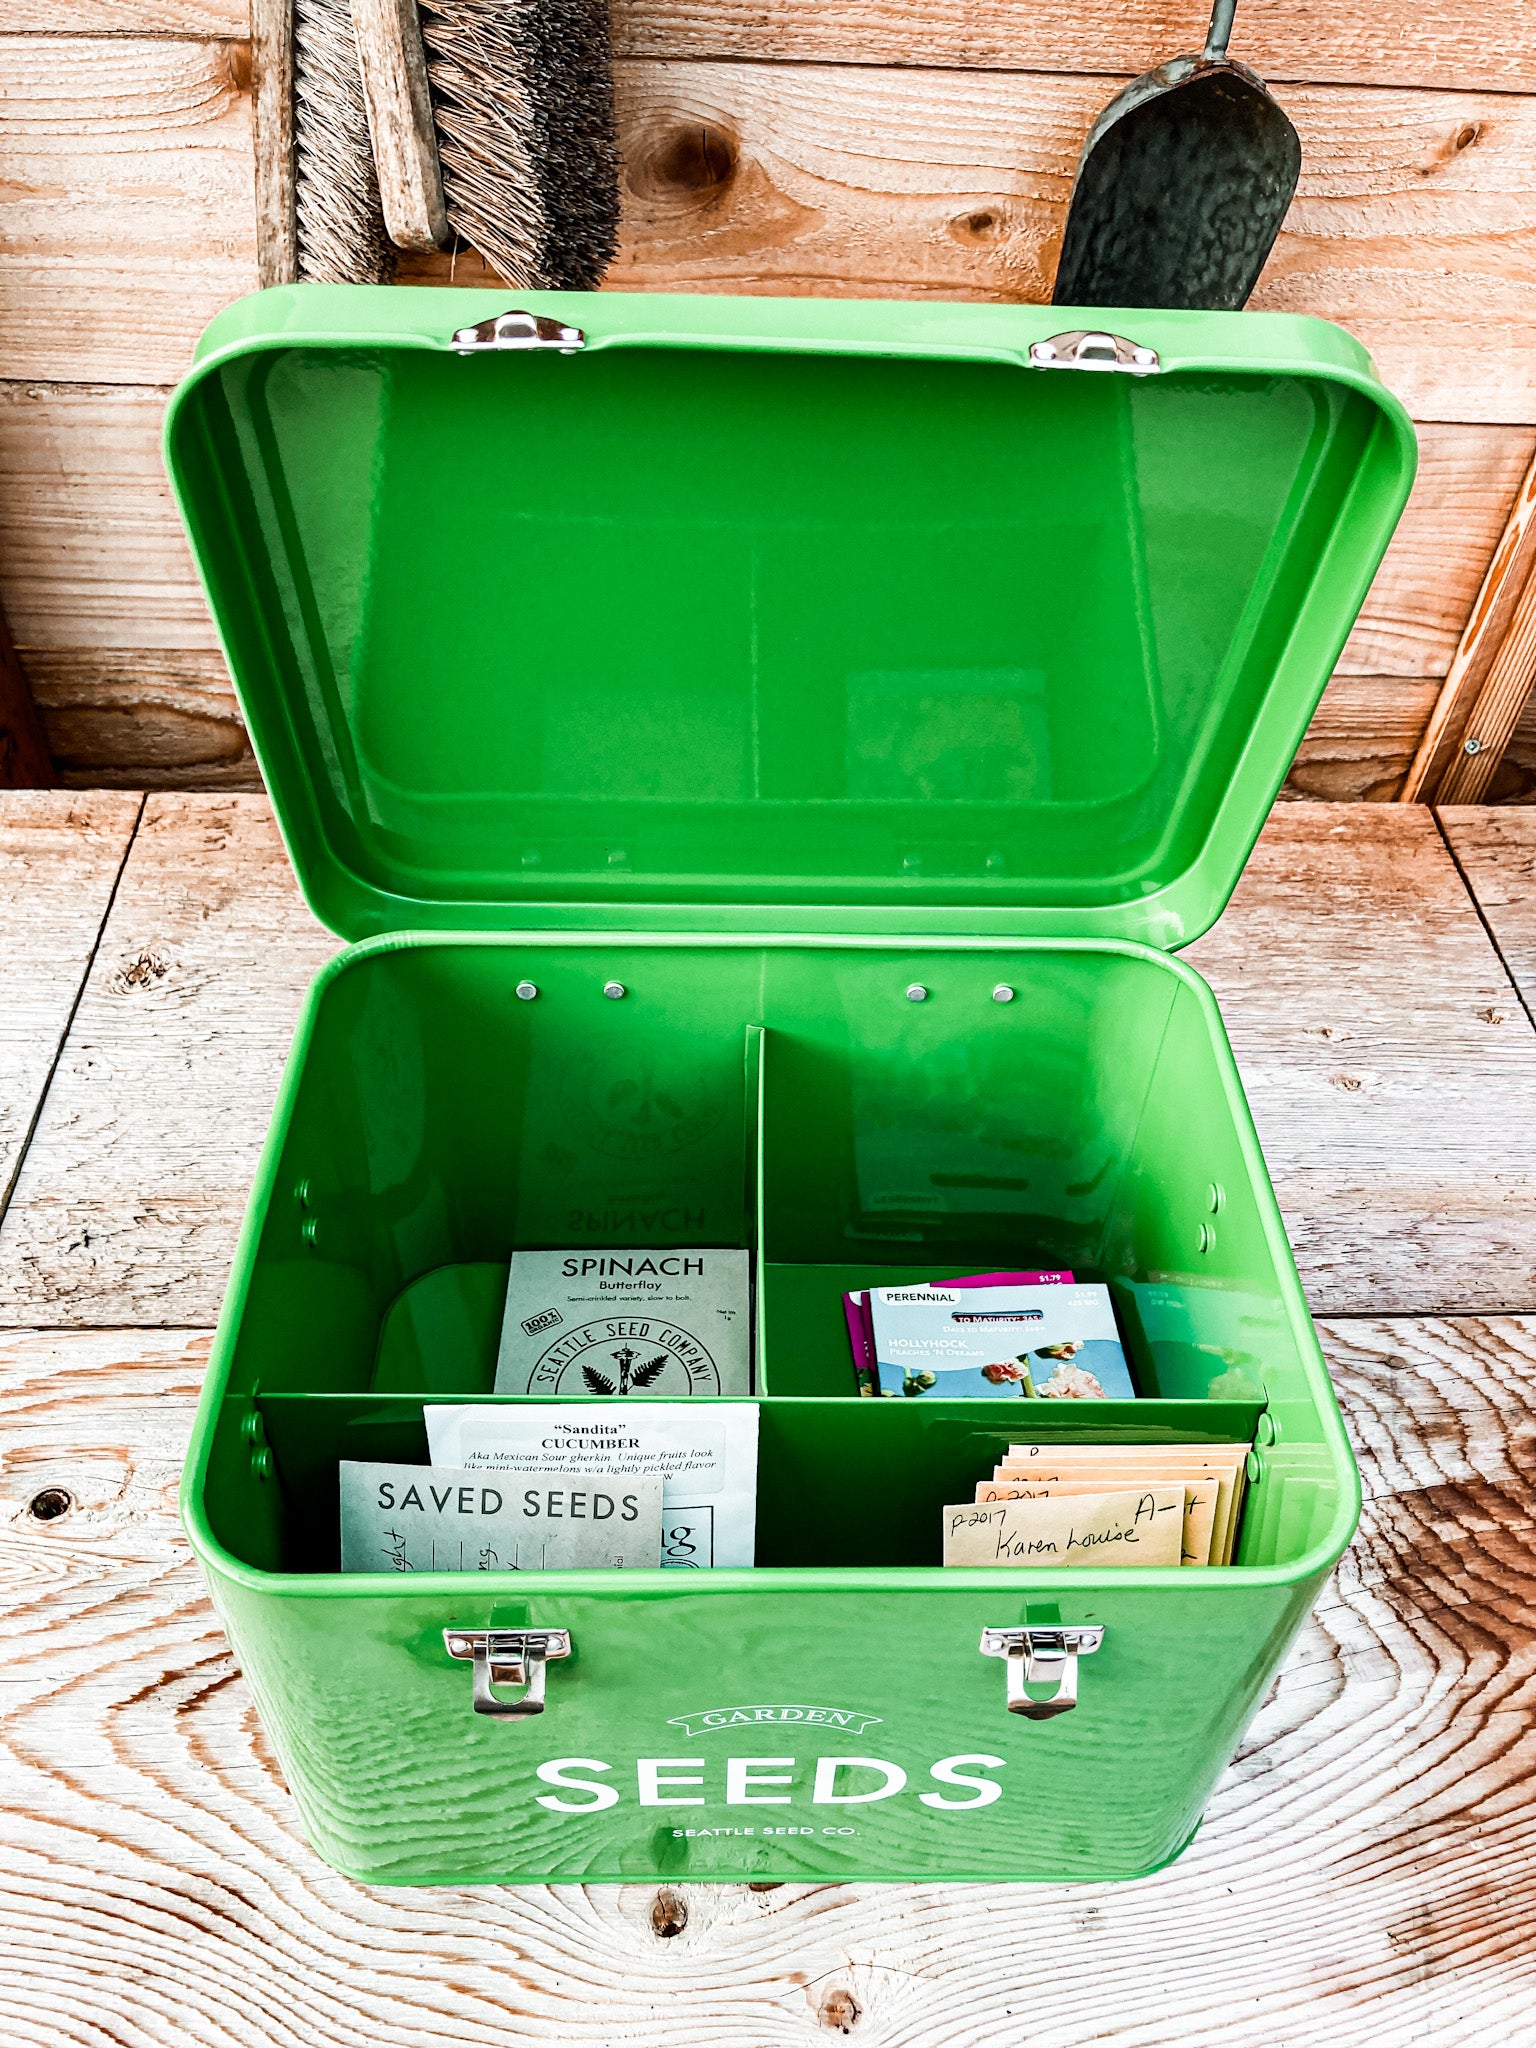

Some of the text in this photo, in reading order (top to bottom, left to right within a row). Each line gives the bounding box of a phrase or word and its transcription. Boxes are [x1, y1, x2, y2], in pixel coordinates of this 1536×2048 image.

[561, 1257, 704, 1277] SPINACH
[599, 1280, 662, 1292] Butterflay
[1039, 1274, 1061, 1282] $1.79
[886, 1292, 955, 1302] PERENNIAL
[525, 1311, 557, 1331] 100%
[888, 1339, 968, 1348] HOLLYHOCK
[537, 1322, 713, 1383] SEATTLE SEED COMPANY
[541, 1438, 640, 1450] CUCUMBER
[468, 1451, 489, 1461] Aka
[492, 1452, 539, 1461] Mexican
[541, 1452, 566, 1461] Sour
[618, 1452, 656, 1463] Unique
[657, 1450, 687, 1462] fruits
[690, 1449, 713, 1459] look
[585, 1464, 604, 1474] w/a
[606, 1463, 641, 1475] lightly
[643, 1461, 682, 1474] pickled
[683, 1460, 717, 1472] flavor
[377, 1482, 639, 1522] SAVED SEEDS
[951, 1510, 1007, 1537] P-2017
[996, 1522, 1140, 1559] Karen Louise
[702, 1708, 854, 1727] GARDEN
[535, 1754, 1008, 1813] SEEDS
[672, 1826, 861, 1838] SEATTLE SEED CO.
